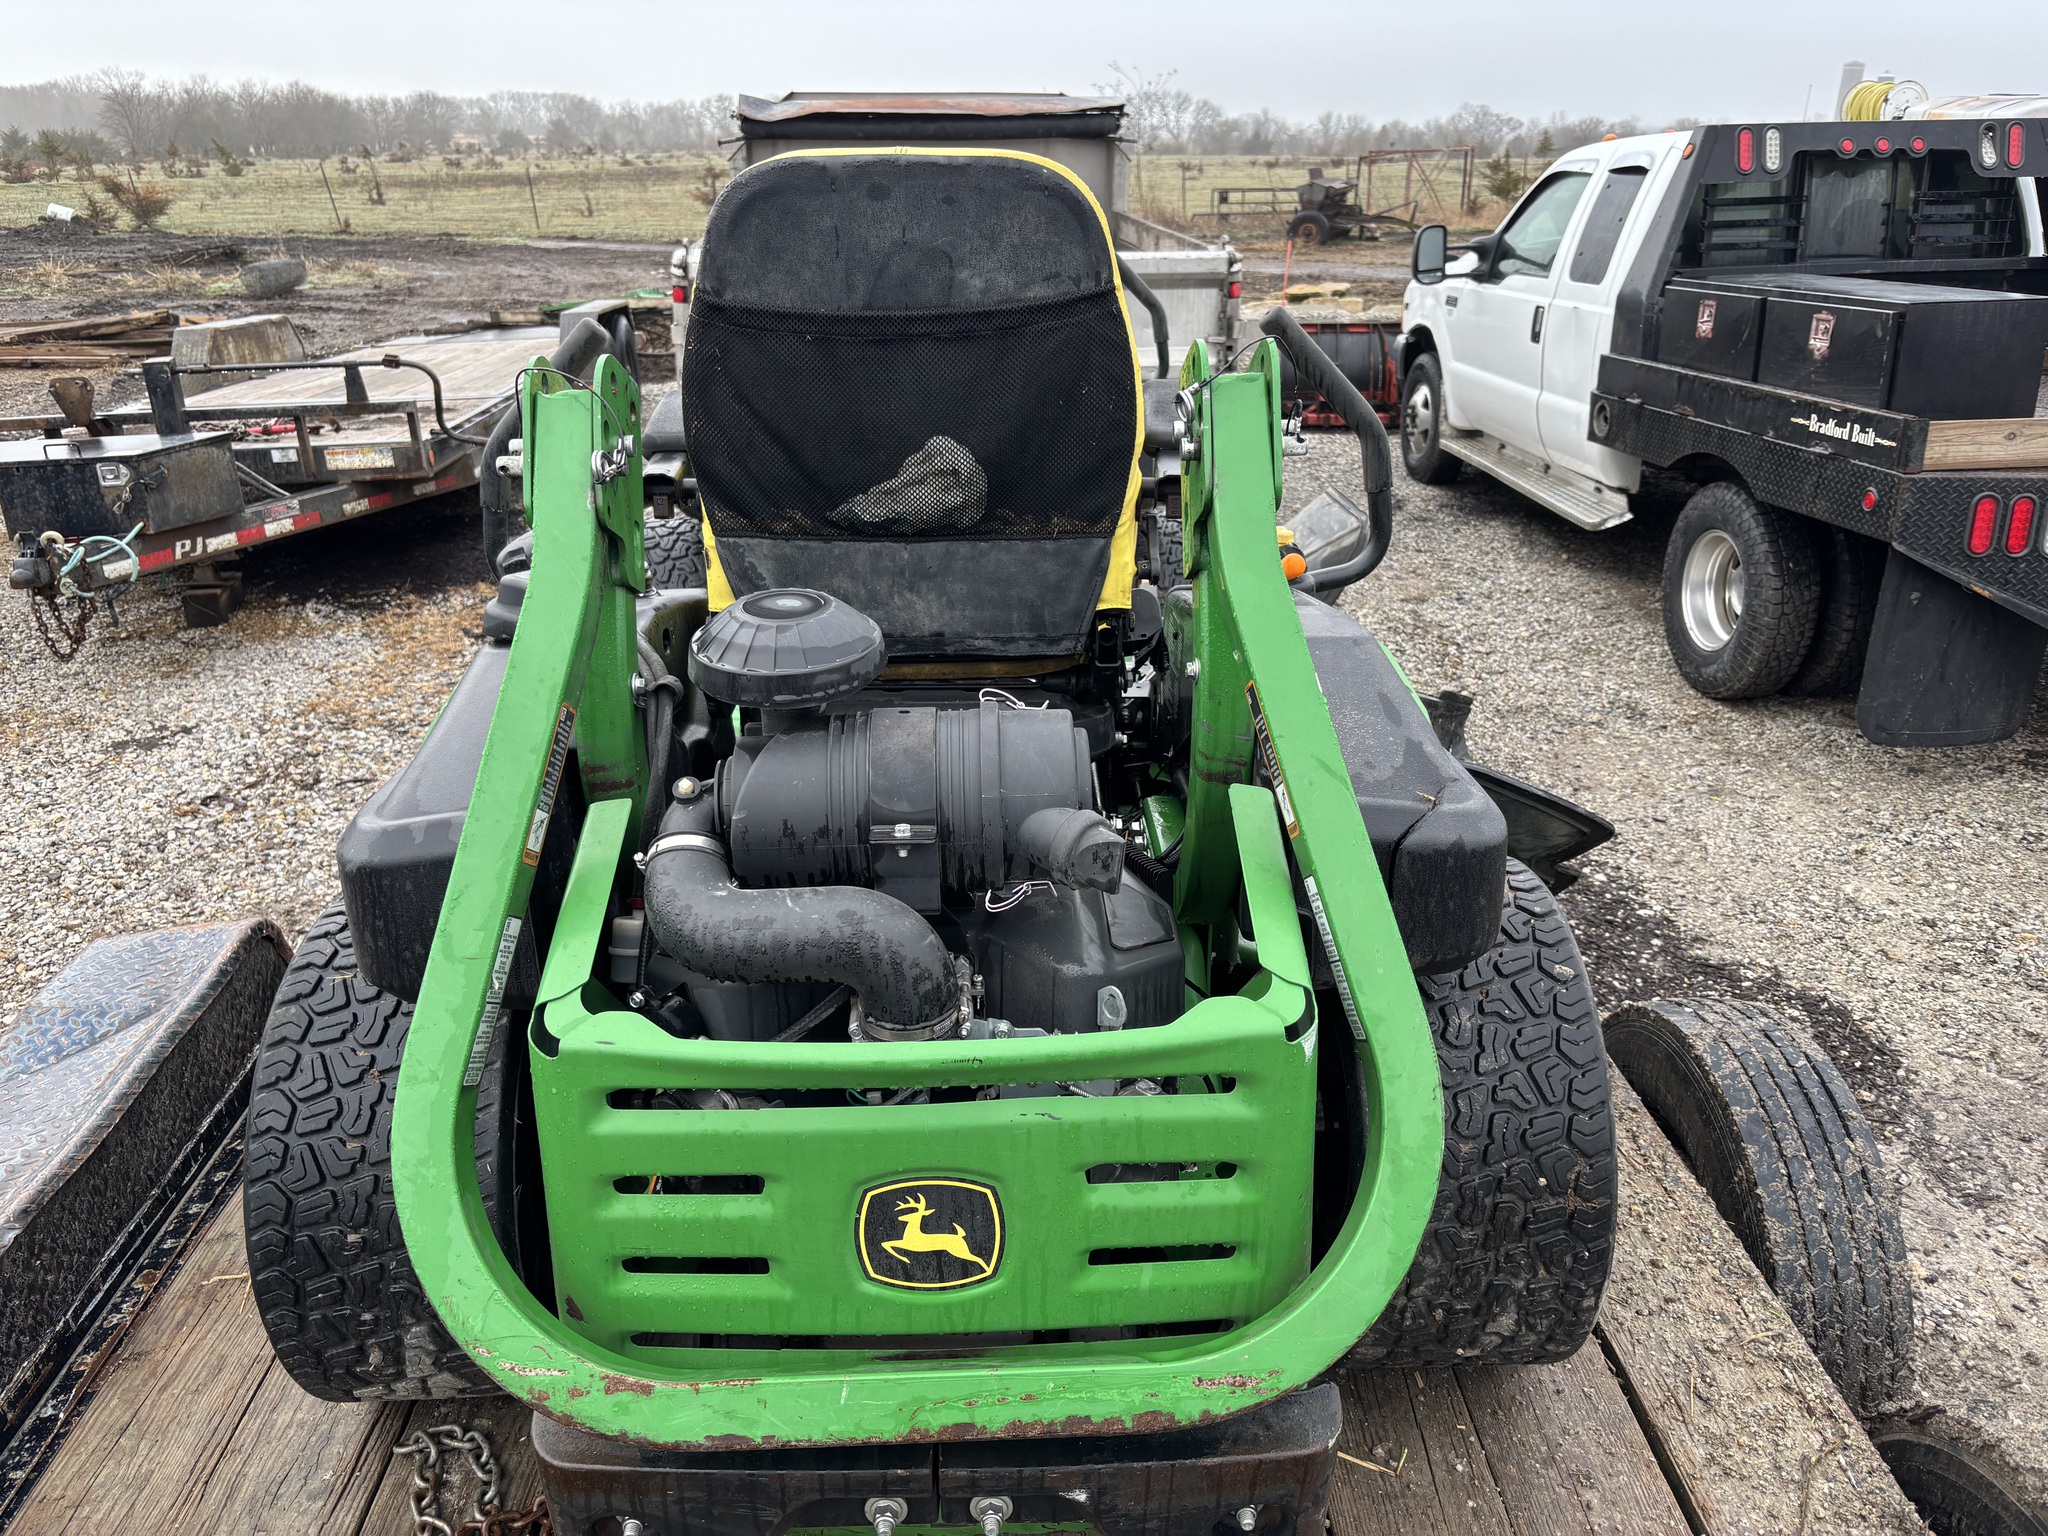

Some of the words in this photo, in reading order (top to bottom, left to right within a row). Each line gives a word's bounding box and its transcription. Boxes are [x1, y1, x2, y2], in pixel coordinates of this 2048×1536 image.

[1809, 414, 1851, 440] Bradford
[1851, 424, 1876, 447] Built
[175, 536, 203, 560] PJ
